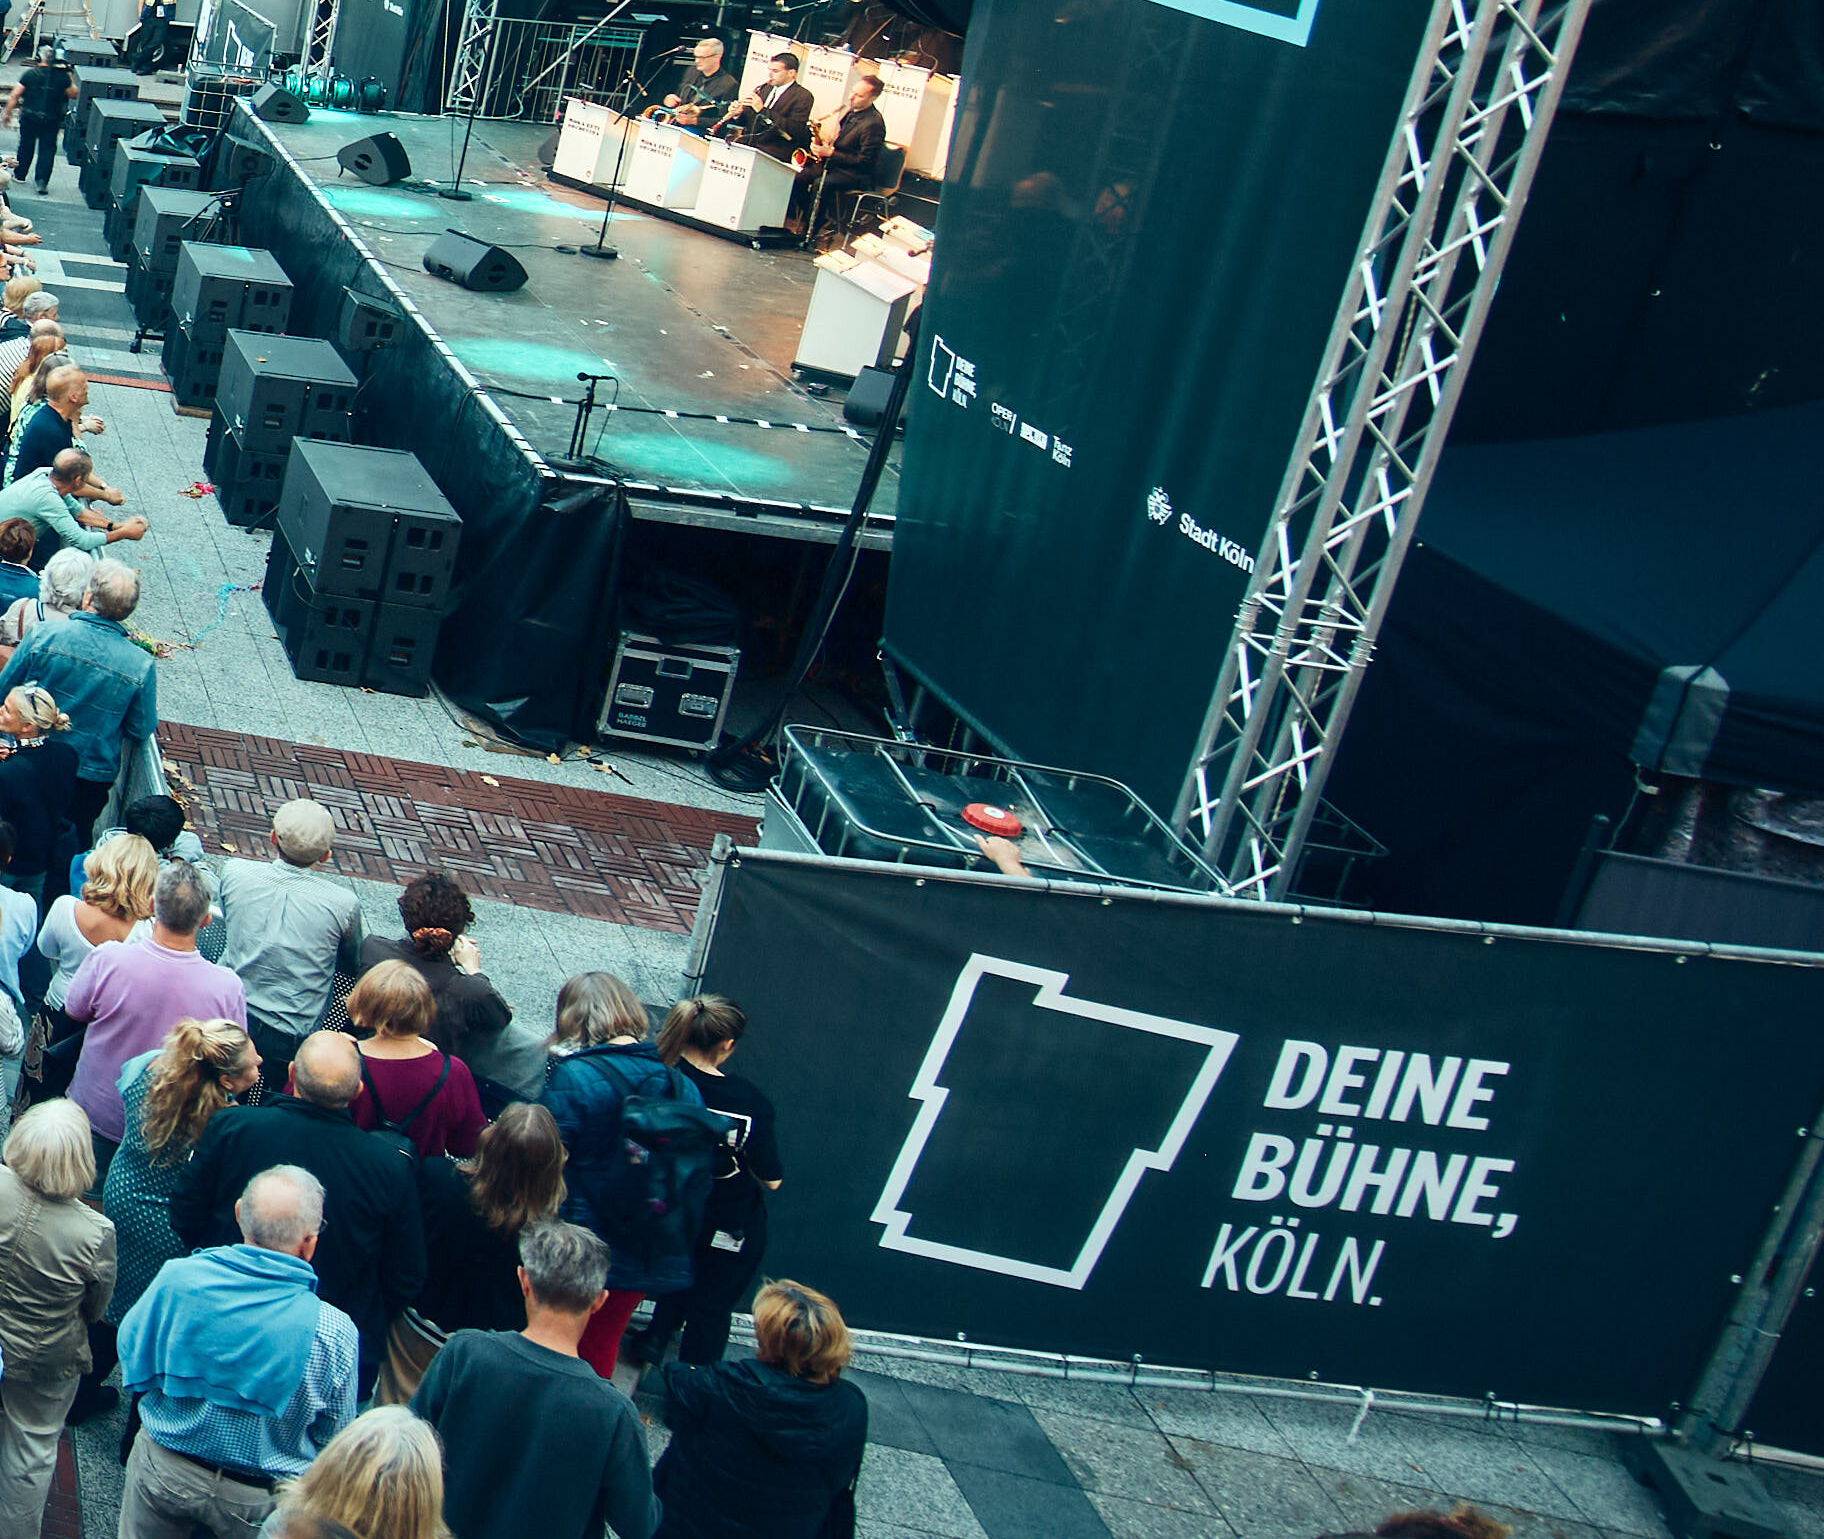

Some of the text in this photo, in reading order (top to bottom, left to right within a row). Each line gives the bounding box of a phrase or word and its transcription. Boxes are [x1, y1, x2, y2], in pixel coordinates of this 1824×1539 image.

[991, 402, 1013, 421] OPER
[1179, 511, 1256, 574] Stadt Köln
[1263, 1038, 1510, 1132] DEINE
[1231, 1122, 1519, 1239] BÜHNE,
[1200, 1215, 1385, 1307] KÖLN.
